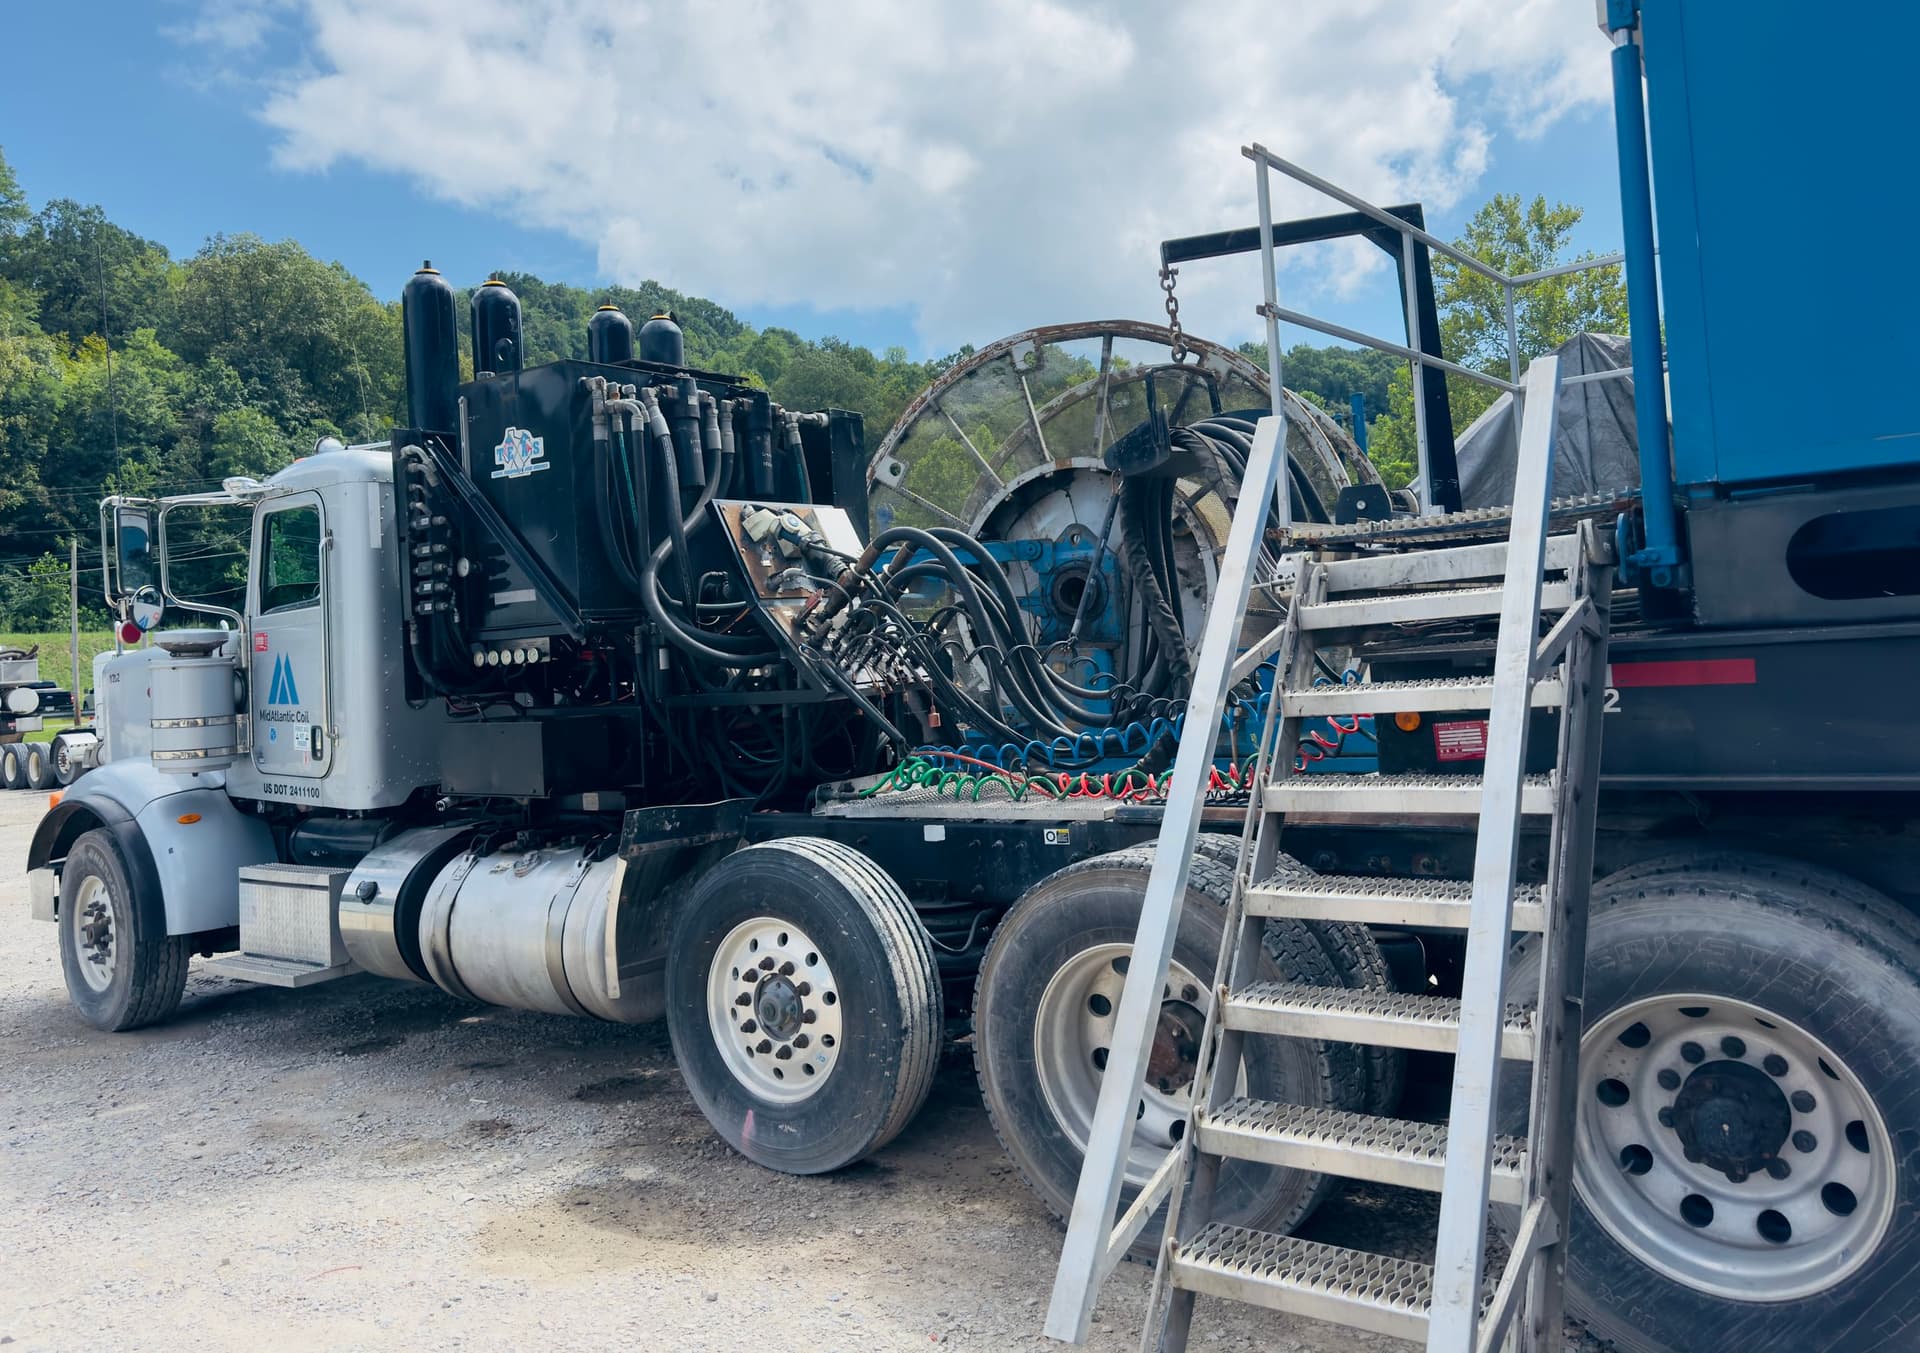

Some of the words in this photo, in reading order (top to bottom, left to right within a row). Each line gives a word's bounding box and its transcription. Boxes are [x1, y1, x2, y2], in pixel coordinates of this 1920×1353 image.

[259, 709, 295, 722] MidAtlantic
[296, 710, 310, 723] Coil
[263, 783, 272, 794] US
[274, 783, 288, 796] DOT
[290, 785, 320, 798] 2411100
